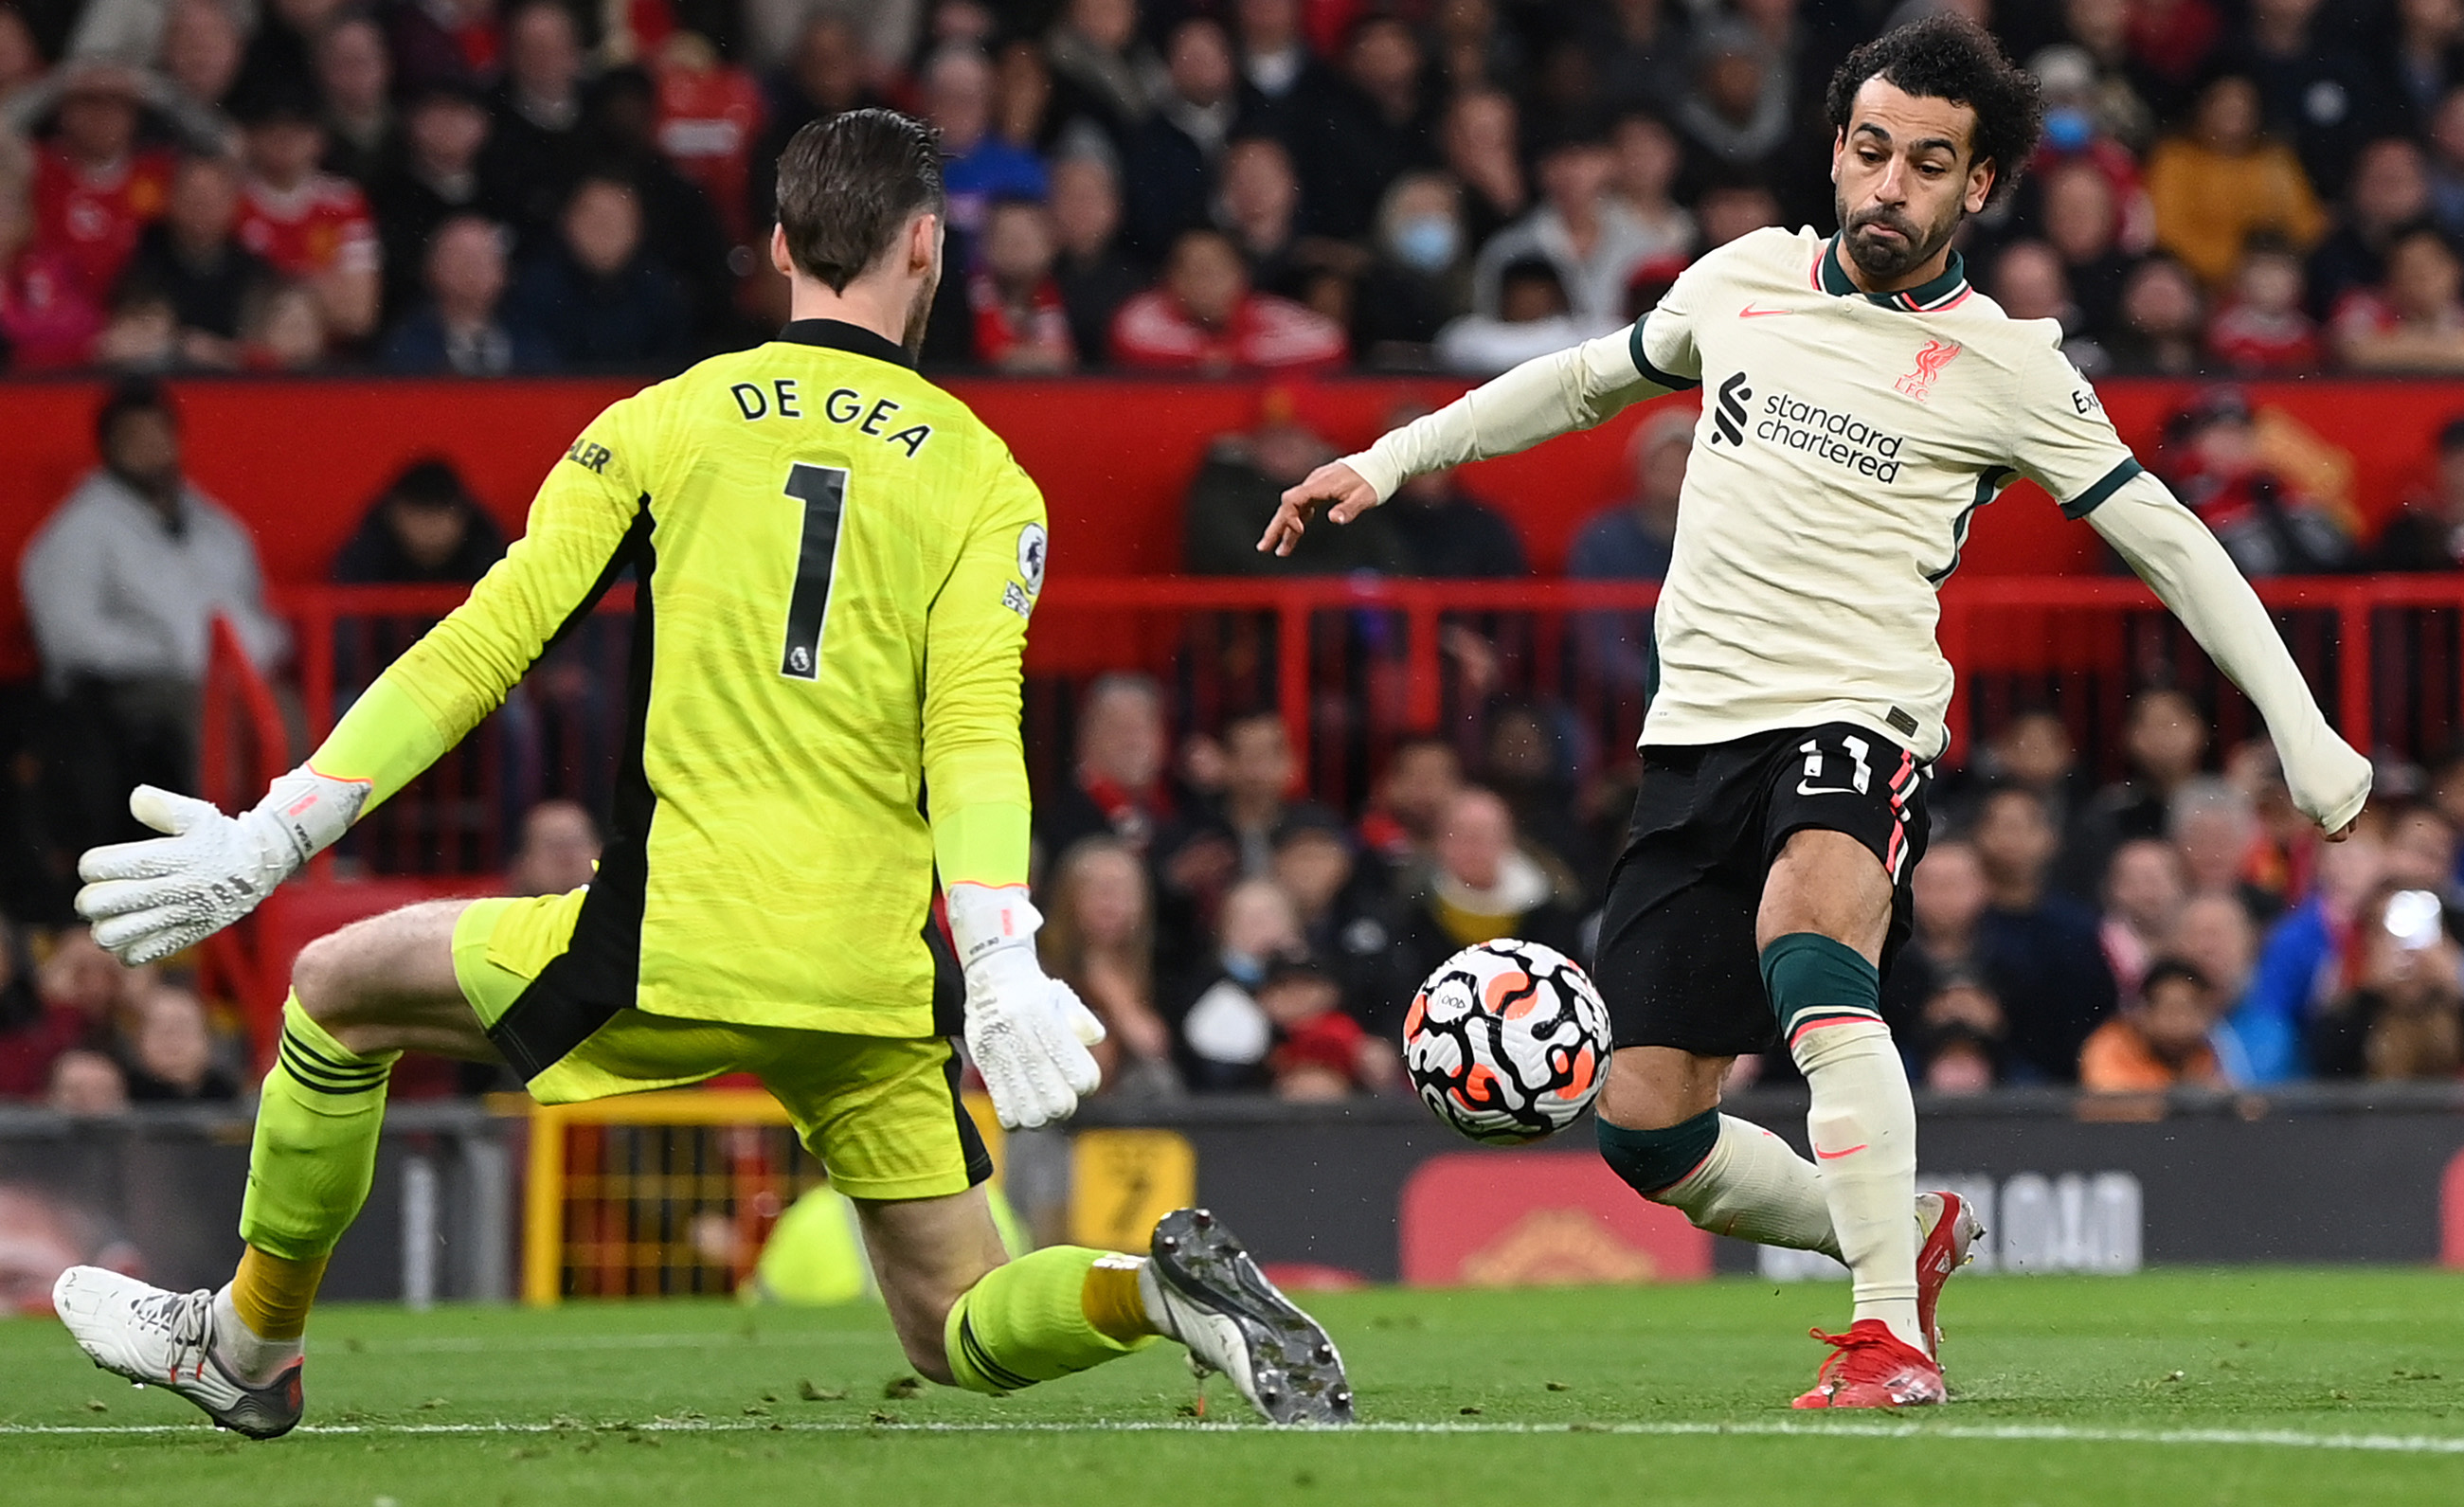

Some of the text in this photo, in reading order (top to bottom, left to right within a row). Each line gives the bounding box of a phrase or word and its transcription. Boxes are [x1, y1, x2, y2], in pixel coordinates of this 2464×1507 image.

[731, 380, 931, 458] DE GEA
[1894, 377, 1929, 402] LFC
[568, 439, 611, 475] LER
[1757, 419, 1900, 484] chartered
[1763, 394, 1903, 459] standard
[780, 460, 850, 680] 1
[1799, 735, 1872, 796] 11
